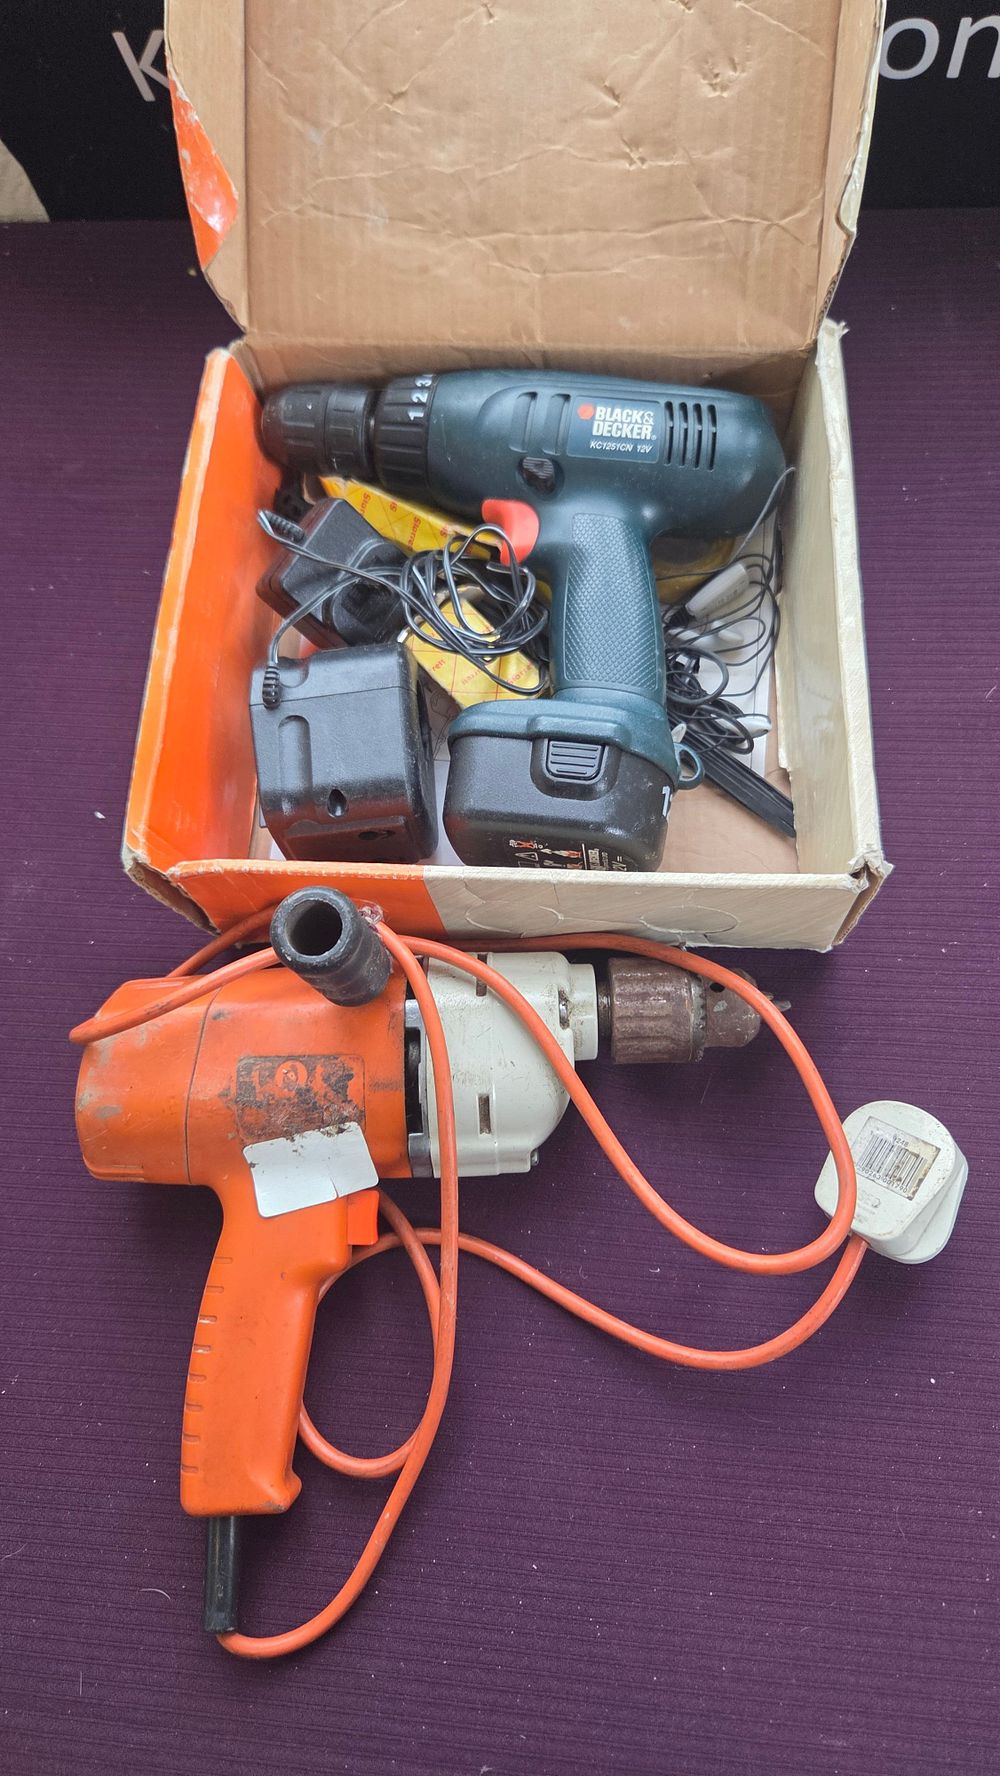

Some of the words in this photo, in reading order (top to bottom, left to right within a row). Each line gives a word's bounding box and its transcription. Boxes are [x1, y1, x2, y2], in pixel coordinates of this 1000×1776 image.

[411, 390, 428, 403] 2
[595, 406, 655, 426] BLACK&
[636, 444, 653, 453] 12V
